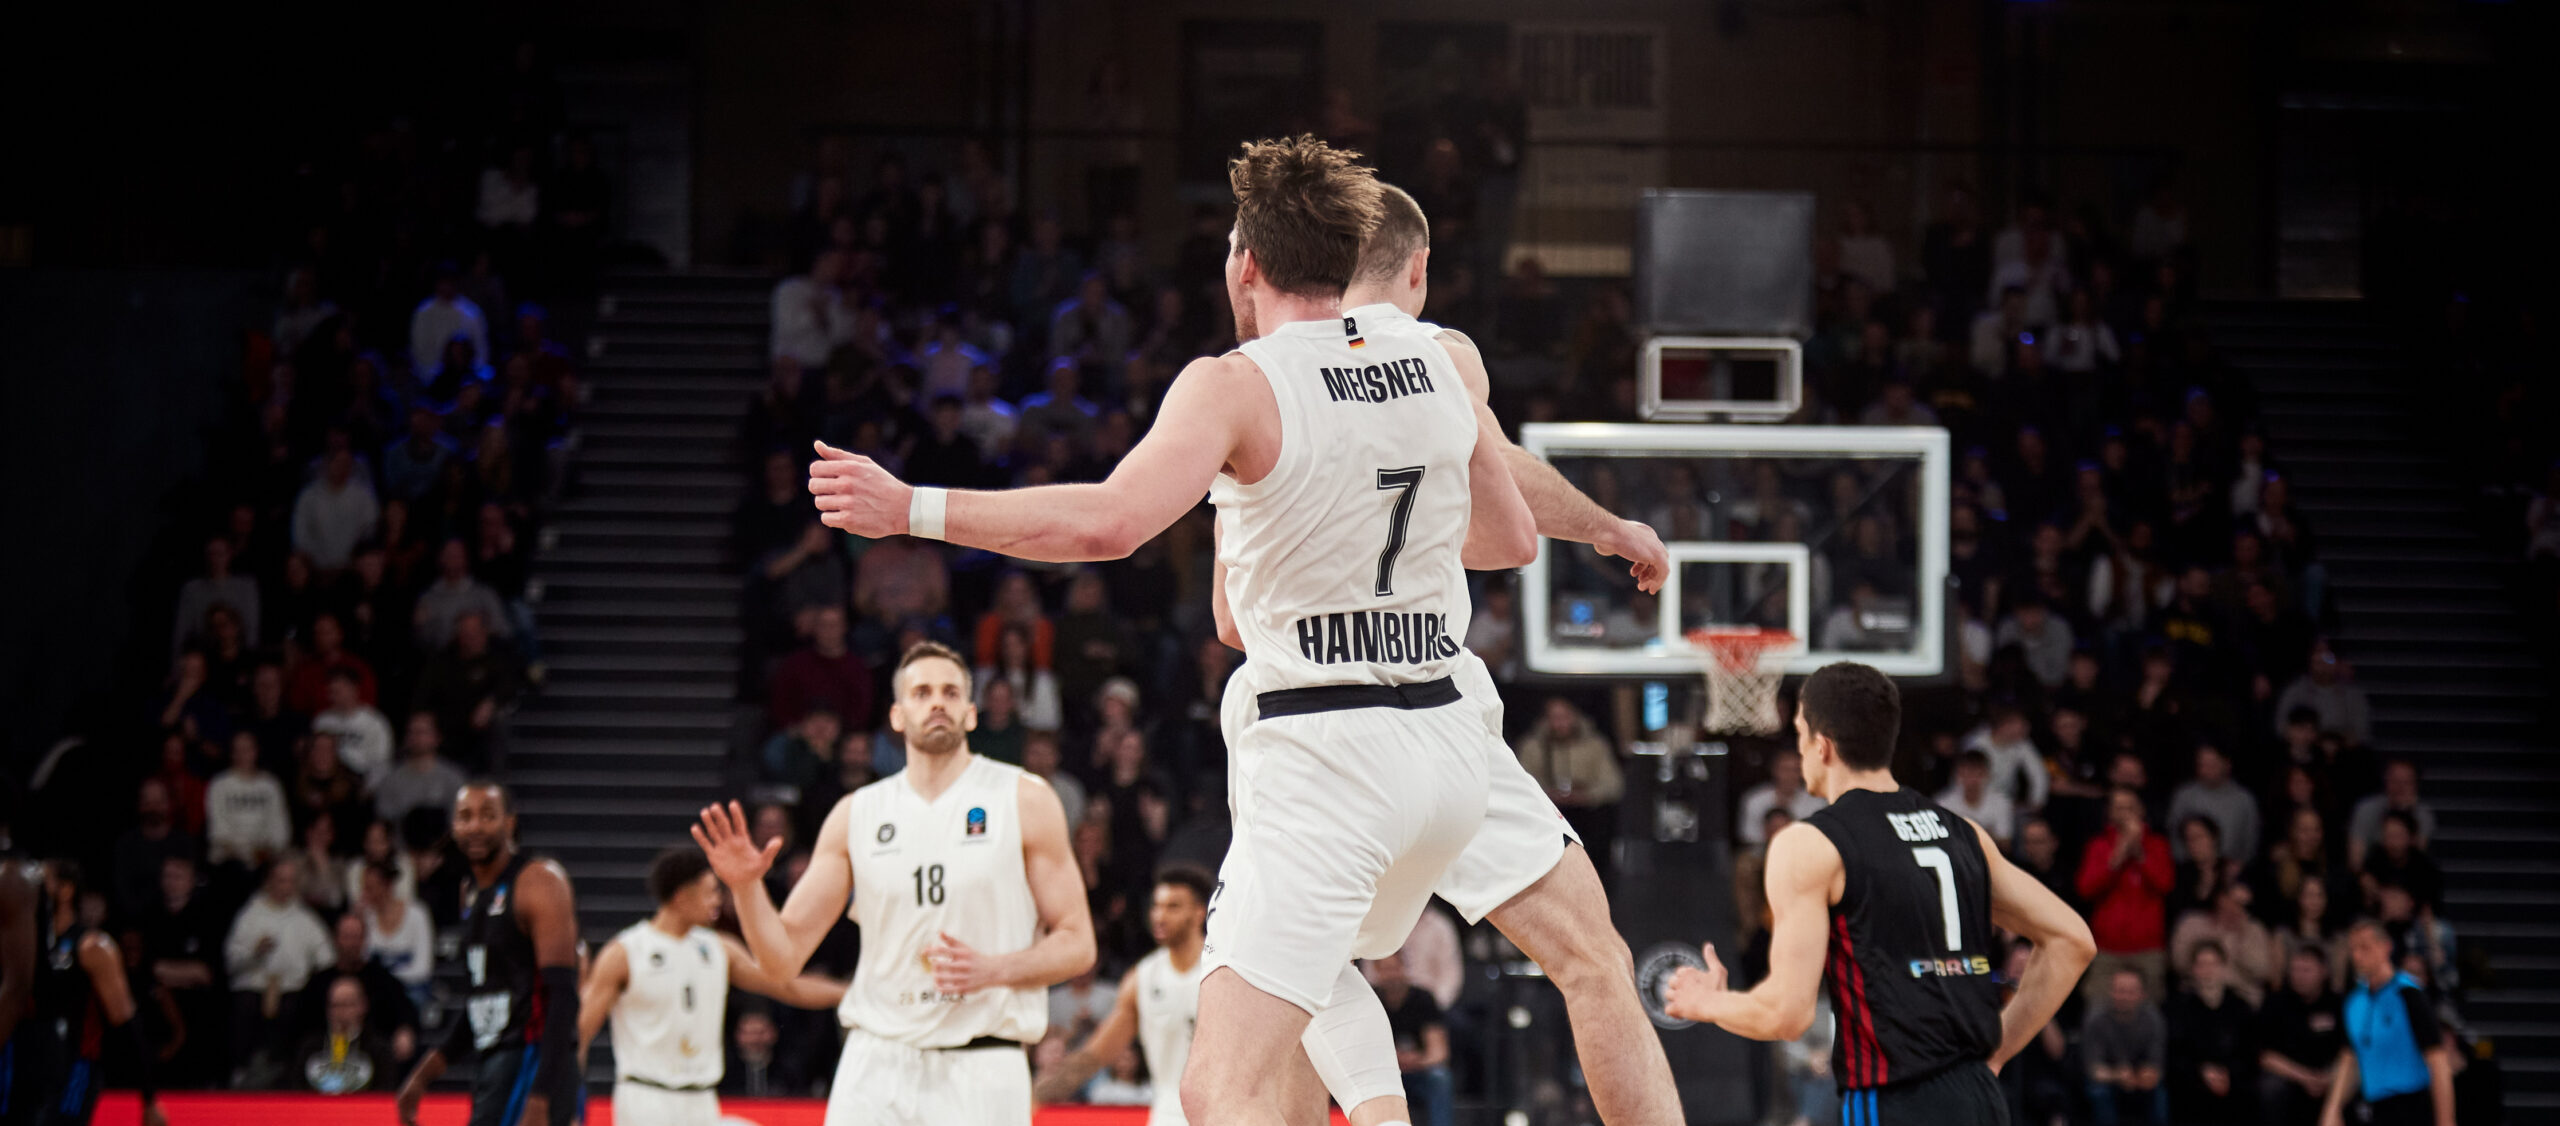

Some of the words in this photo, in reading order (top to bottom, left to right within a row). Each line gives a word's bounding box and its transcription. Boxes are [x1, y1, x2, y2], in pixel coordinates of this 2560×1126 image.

[1320, 357, 1436, 404] MEISNER
[1375, 465, 1426, 597] 7
[1296, 611, 1460, 665] HAMBURG
[913, 863, 945, 908] 18
[1911, 846, 1963, 952] 7
[1909, 956, 1992, 979] PARIS
